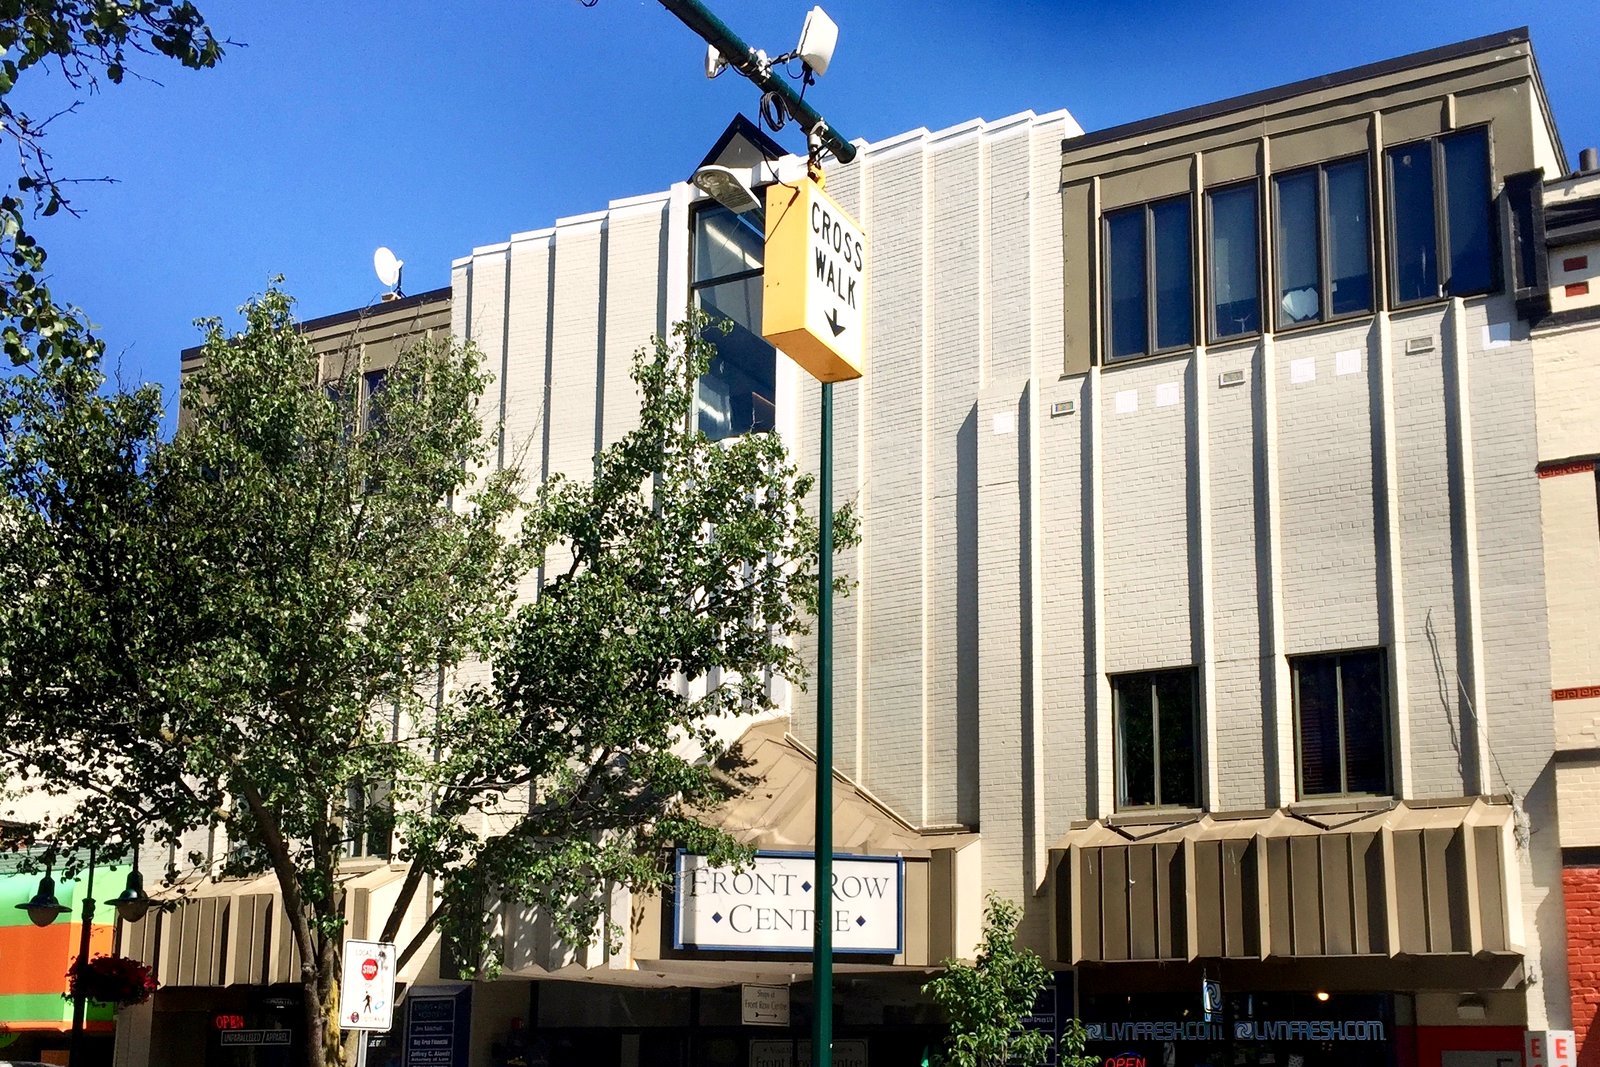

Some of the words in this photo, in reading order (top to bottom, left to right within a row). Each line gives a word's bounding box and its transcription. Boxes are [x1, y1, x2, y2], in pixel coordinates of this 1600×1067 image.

[811, 201, 864, 273] CROSS
[815, 246, 857, 310] WALK
[689, 868, 798, 897] FRONT
[729, 903, 851, 934] CENTE
[362, 964, 377, 974] STOP
[744, 1000, 758, 1008] Front
[215, 1015, 244, 1029] OPEN
[265, 1031, 289, 1042] APPAREL
[1104, 1056, 1146, 1067] OPEN
